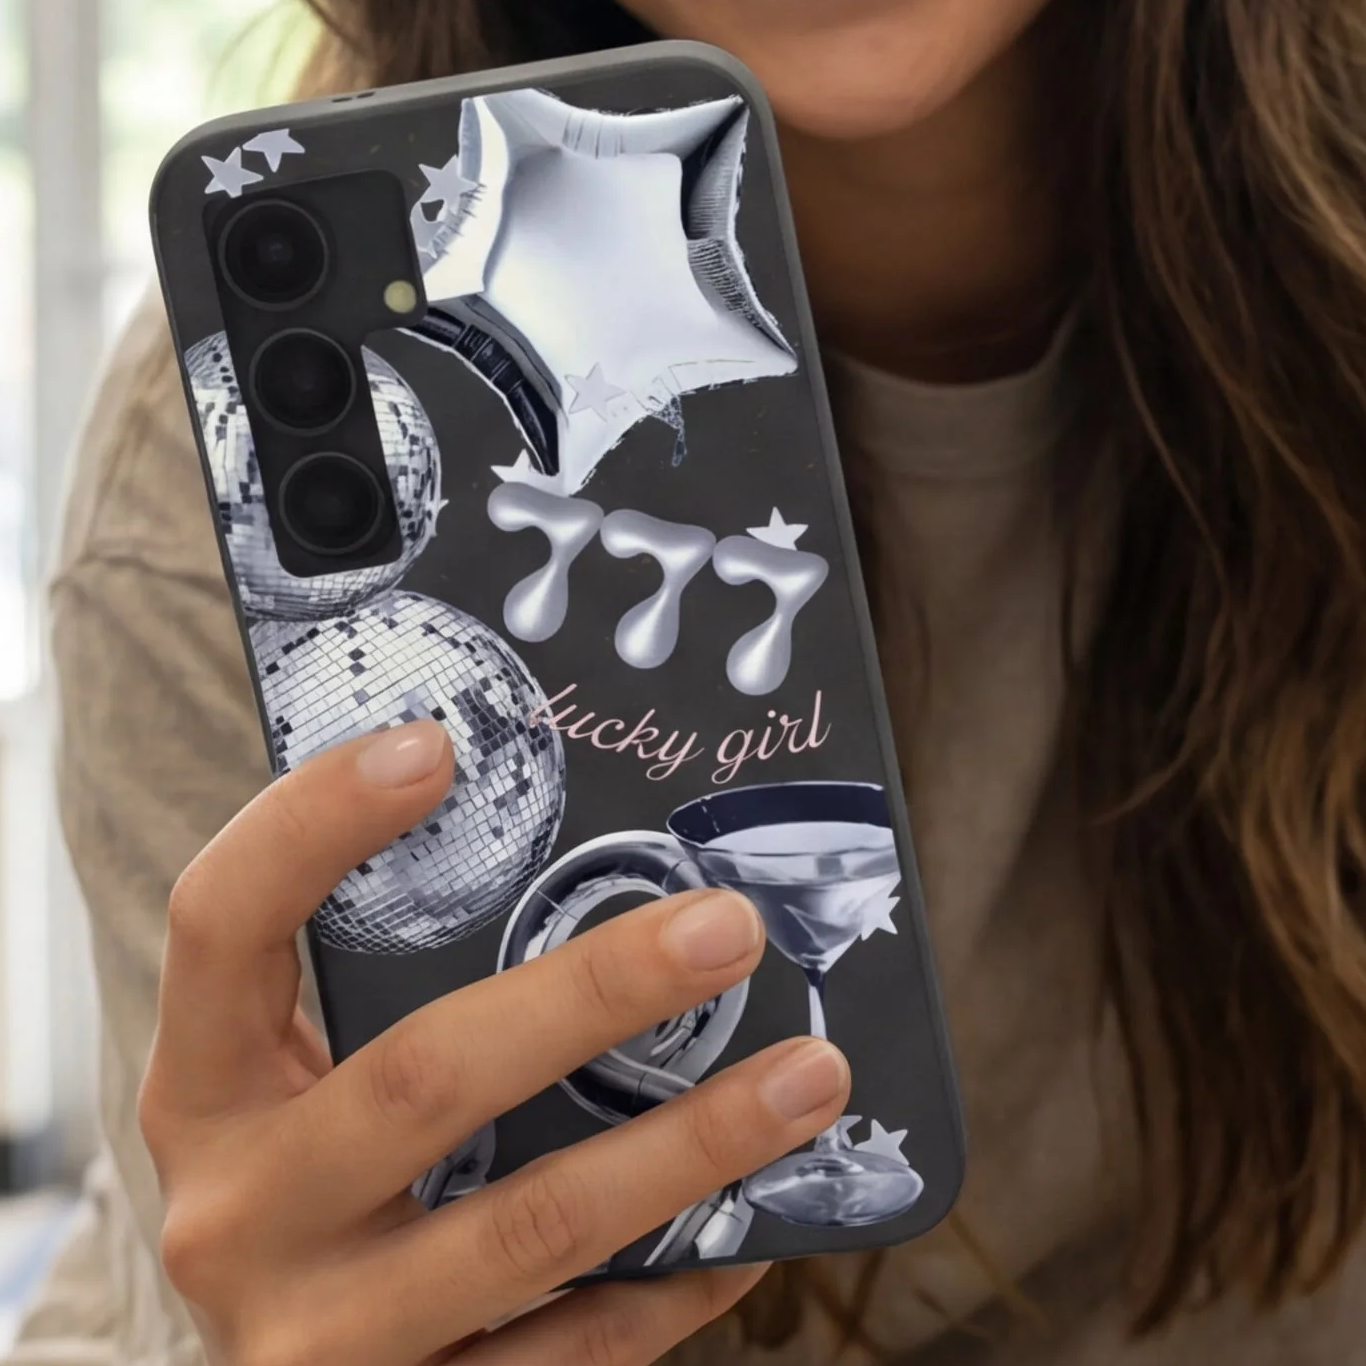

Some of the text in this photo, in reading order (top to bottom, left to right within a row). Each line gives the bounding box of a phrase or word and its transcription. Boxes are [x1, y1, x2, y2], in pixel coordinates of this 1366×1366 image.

[487, 481, 829, 696] 777
[529, 683, 831, 784] lucky girl
